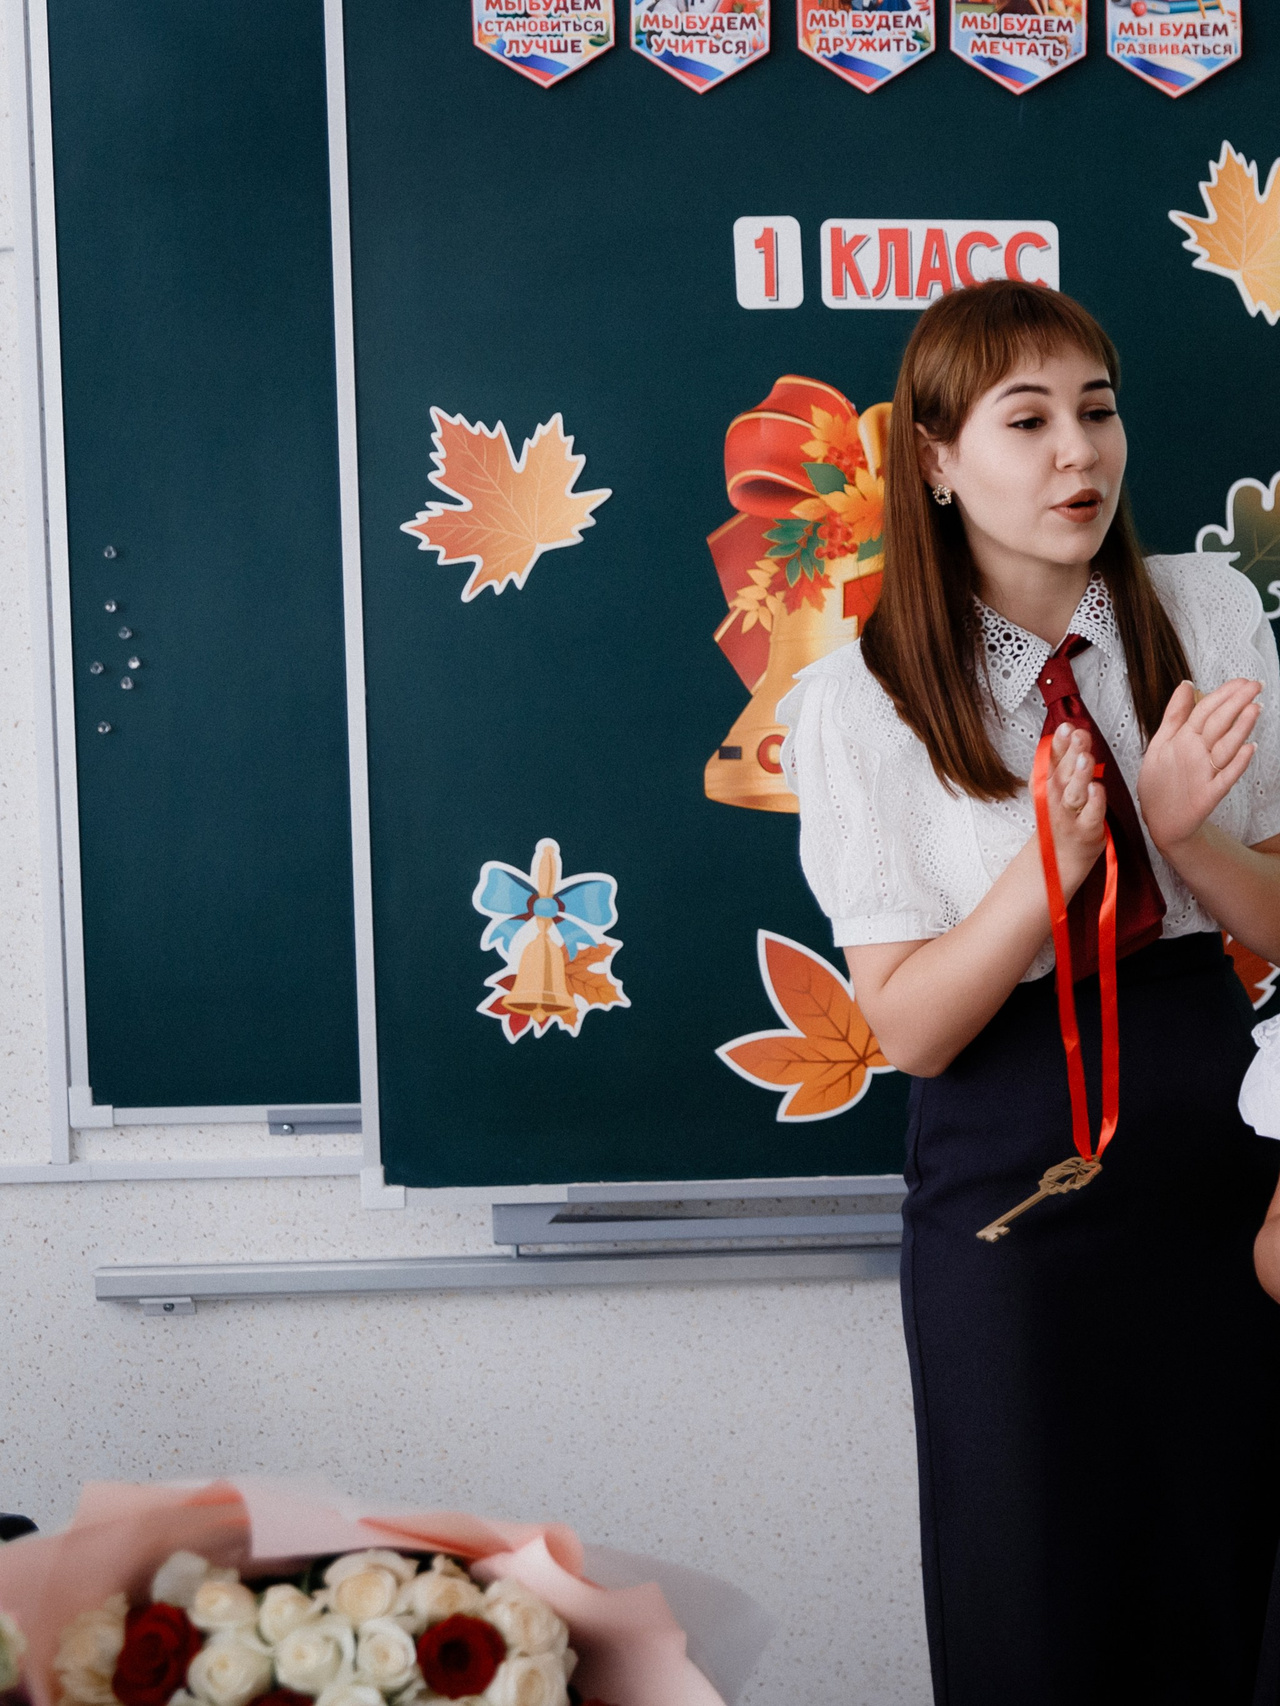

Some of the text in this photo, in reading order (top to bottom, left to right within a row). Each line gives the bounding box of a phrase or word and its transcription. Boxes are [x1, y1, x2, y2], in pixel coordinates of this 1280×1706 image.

[485, 0, 602, 14] МЫ БУДЕМ
[484, 20, 604, 32] СТАНОВИТЬСЯ
[641, 16, 758, 35] МЫ БУДЕМ
[808, 13, 923, 31] МЫ БУДЕМ
[960, 16, 1074, 36] МЫ БУДЕМ
[1117, 22, 1229, 39] МЫ БУДЕМ
[506, 39, 583, 55] ЛУЧШЕ
[651, 38, 748, 56] УЧИТЬСЯ
[816, 37, 918, 54] ДРУЖИТЬ
[970, 38, 1064, 57] МЕЧТАТЬ
[1116, 43, 1233, 57] РАЗВИВАТЬСЯ
[754, 226, 1052, 301] 1 КЛАСС
